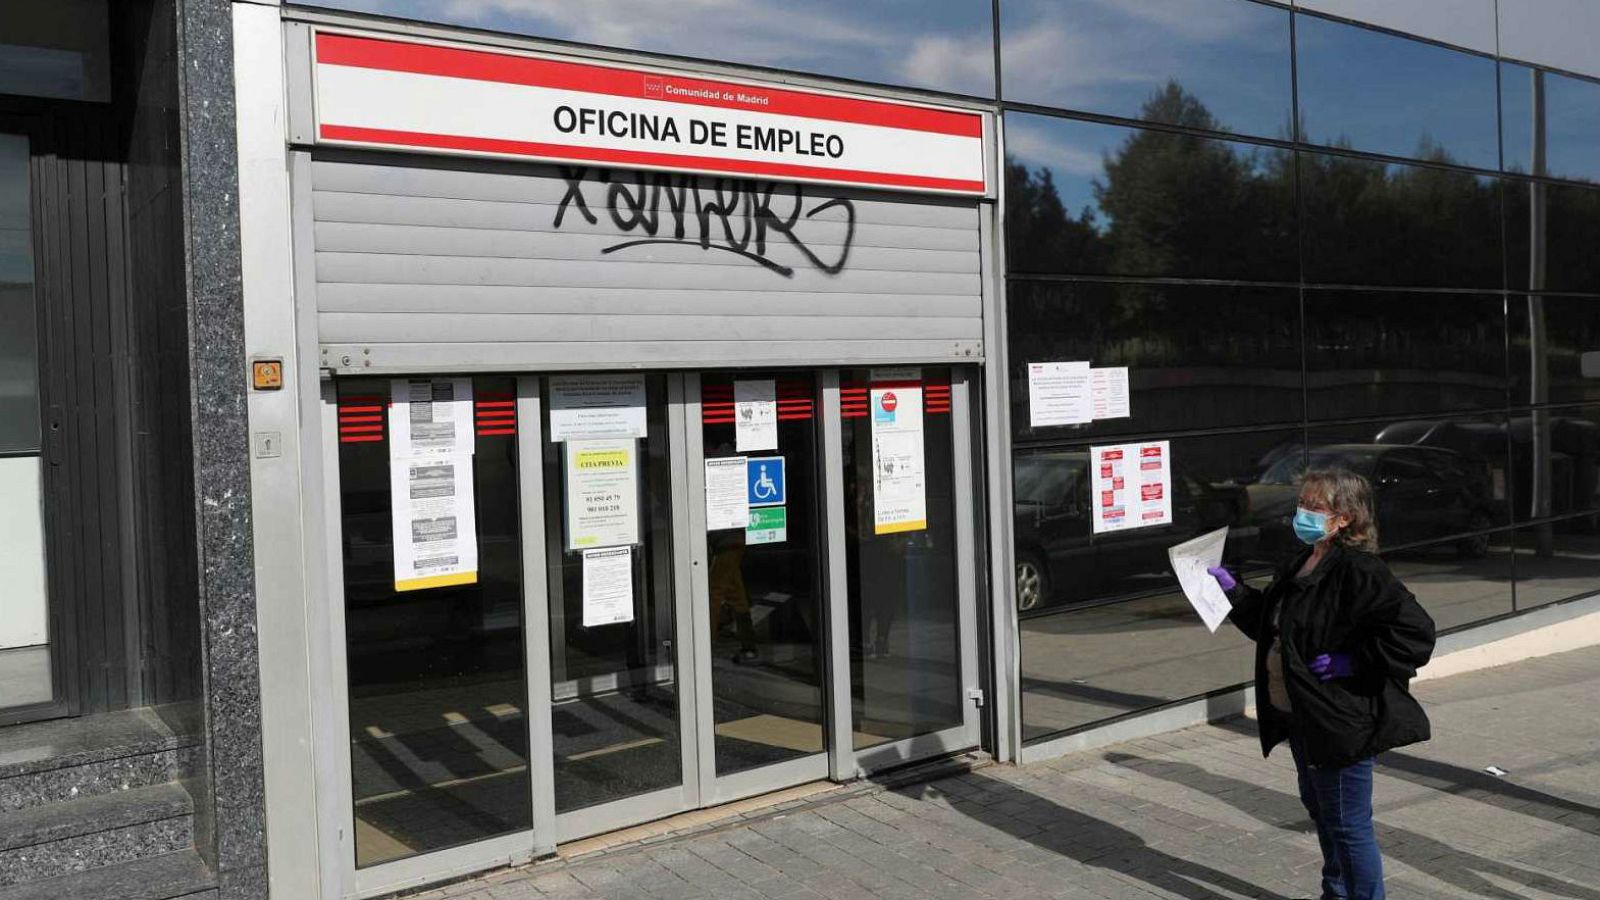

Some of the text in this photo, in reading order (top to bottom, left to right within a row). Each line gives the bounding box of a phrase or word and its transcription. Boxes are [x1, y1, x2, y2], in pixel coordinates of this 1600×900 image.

[665, 85, 768, 105] Comunidad de Madrid
[553, 105, 844, 159] OFICINA DE EMPLEO
